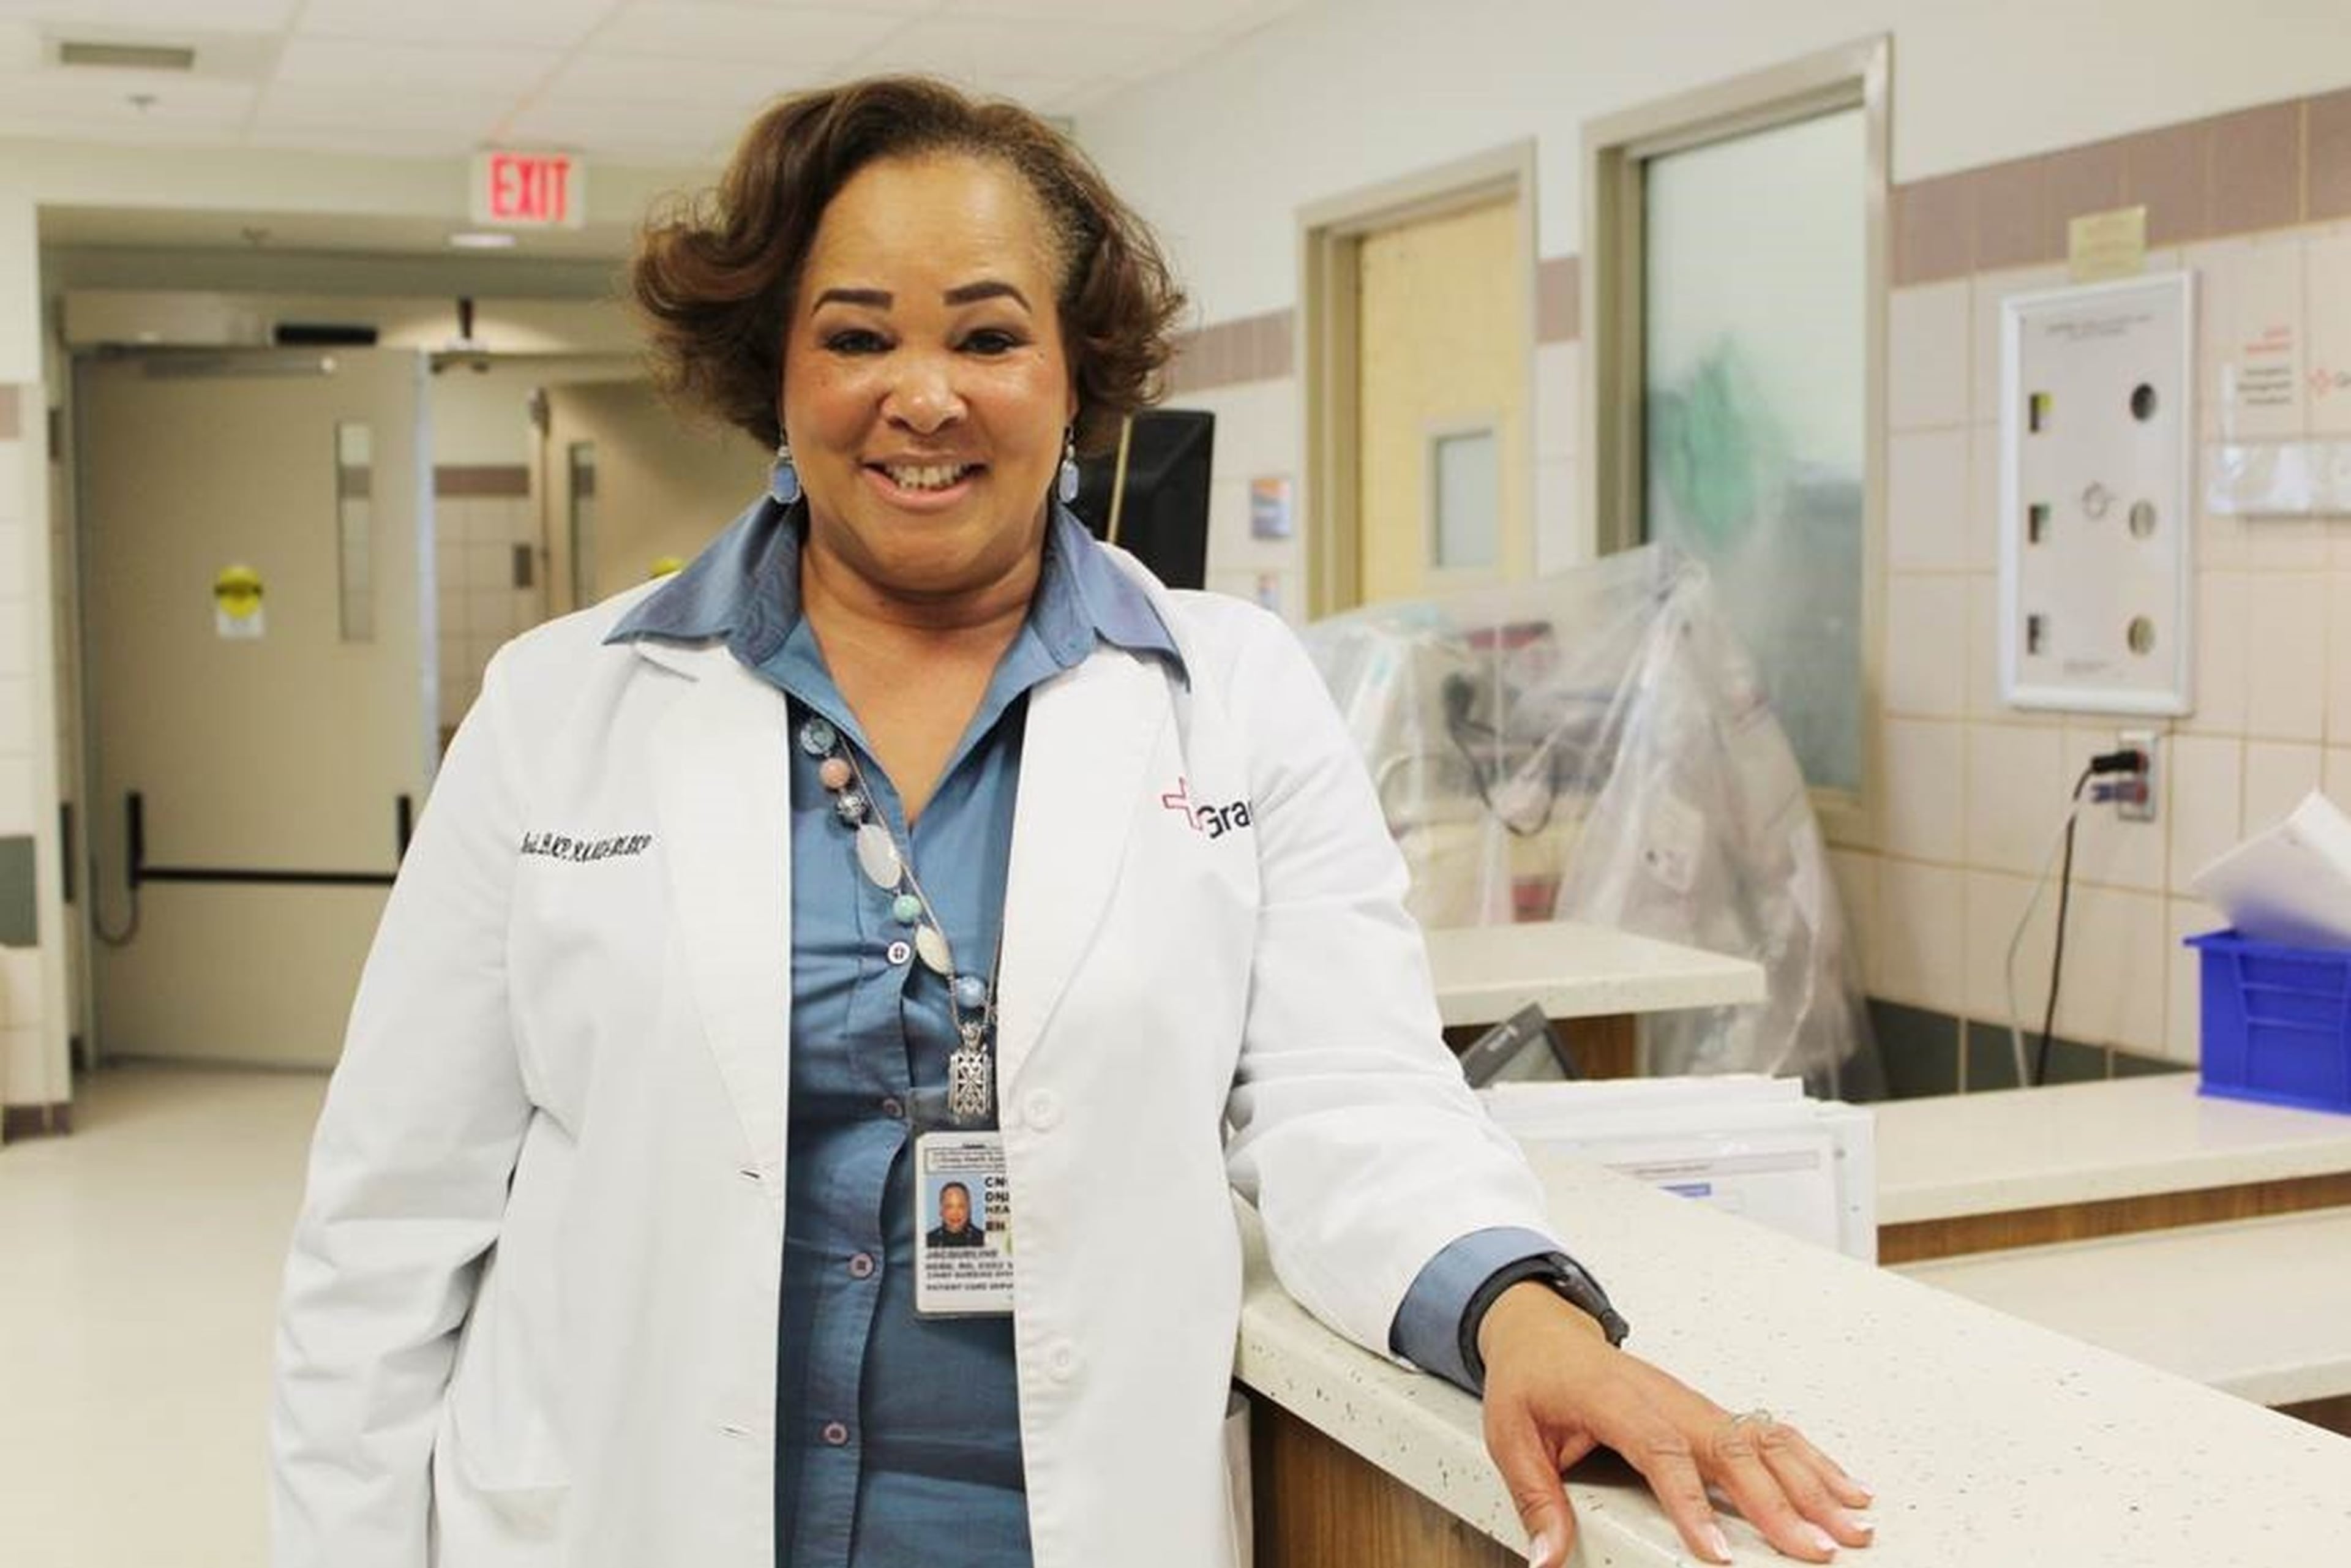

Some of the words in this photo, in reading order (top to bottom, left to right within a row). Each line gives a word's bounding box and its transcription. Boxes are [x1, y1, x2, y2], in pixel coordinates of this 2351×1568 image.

[491, 155, 570, 221] EXIT
[1197, 800, 1253, 839] Gra
[984, 1176, 1008, 1187] CN
